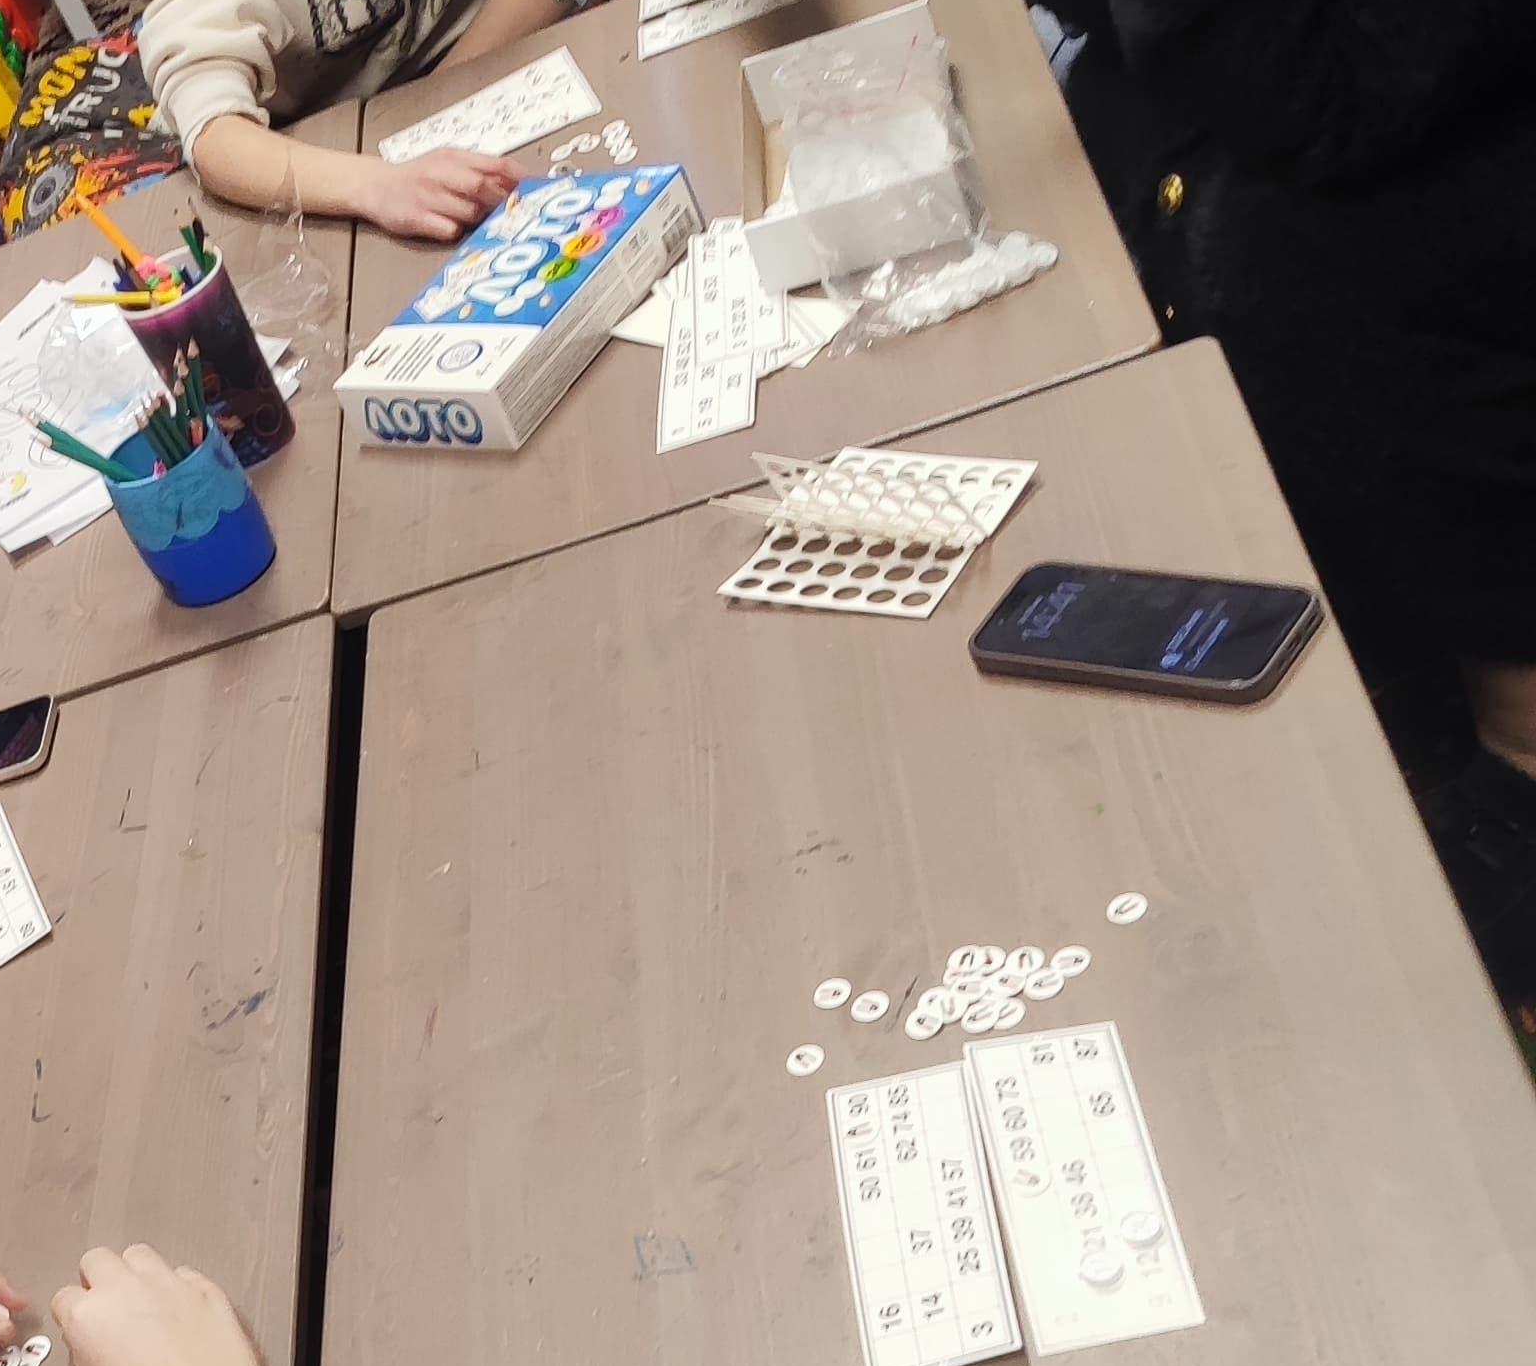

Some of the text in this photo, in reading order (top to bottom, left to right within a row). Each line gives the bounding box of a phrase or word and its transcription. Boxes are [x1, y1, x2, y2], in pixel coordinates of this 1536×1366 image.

[993, 1076, 1017, 1102] 73
[889, 1109, 913, 1132] 74
[938, 1158, 965, 1182] 57
[943, 1188, 968, 1210] 41
[847, 1094, 902, 1332] 16 50 61 90
[908, 1230, 933, 1254] 37
[957, 1246, 982, 1275] 25
[919, 1290, 945, 1320] 14
[969, 1320, 994, 1339] 3
